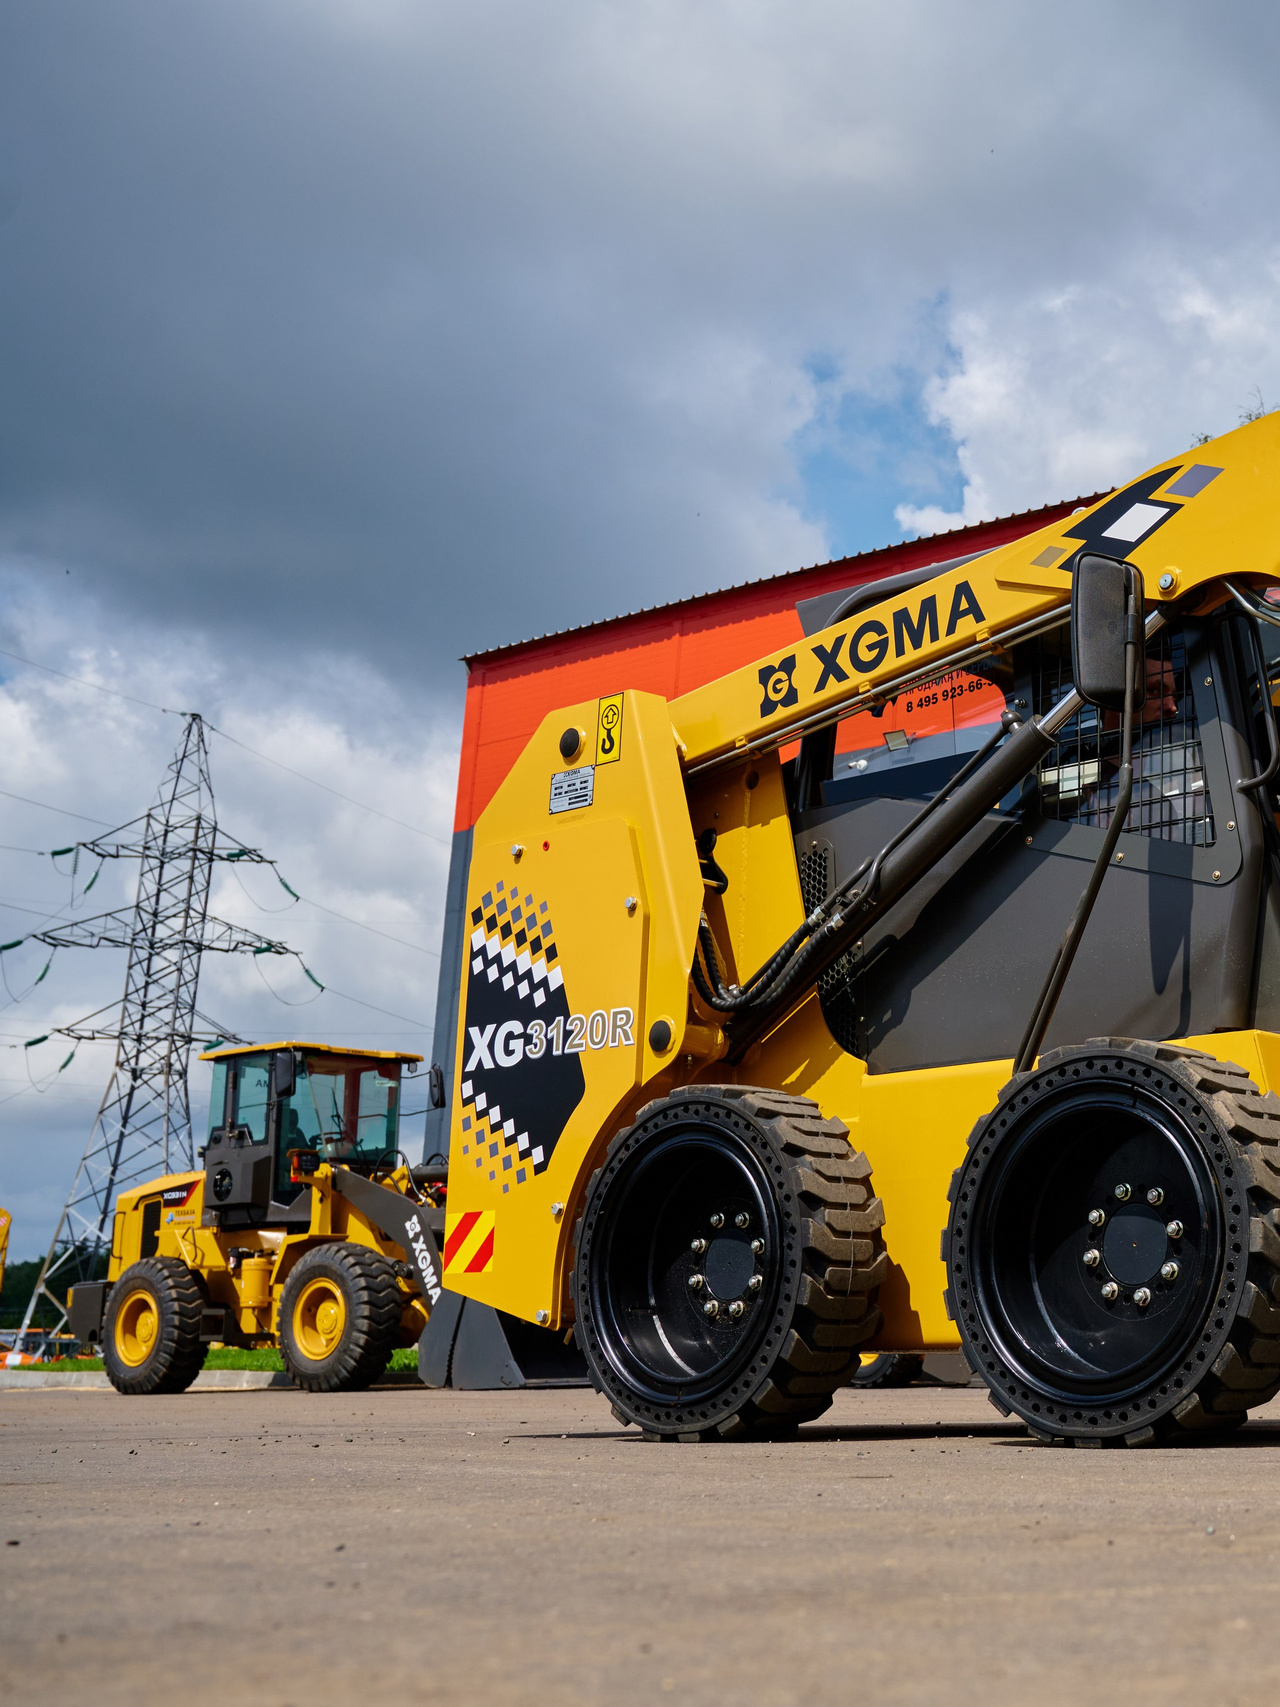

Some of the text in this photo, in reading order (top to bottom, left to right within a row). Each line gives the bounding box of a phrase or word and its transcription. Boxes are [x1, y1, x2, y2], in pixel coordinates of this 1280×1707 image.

[811, 580, 986, 694] XGMA
[906, 701, 914, 713] 8
[917, 693, 939, 709] 495
[464, 1007, 635, 1072] XG3120R
[411, 1234, 441, 1306] XGMA
